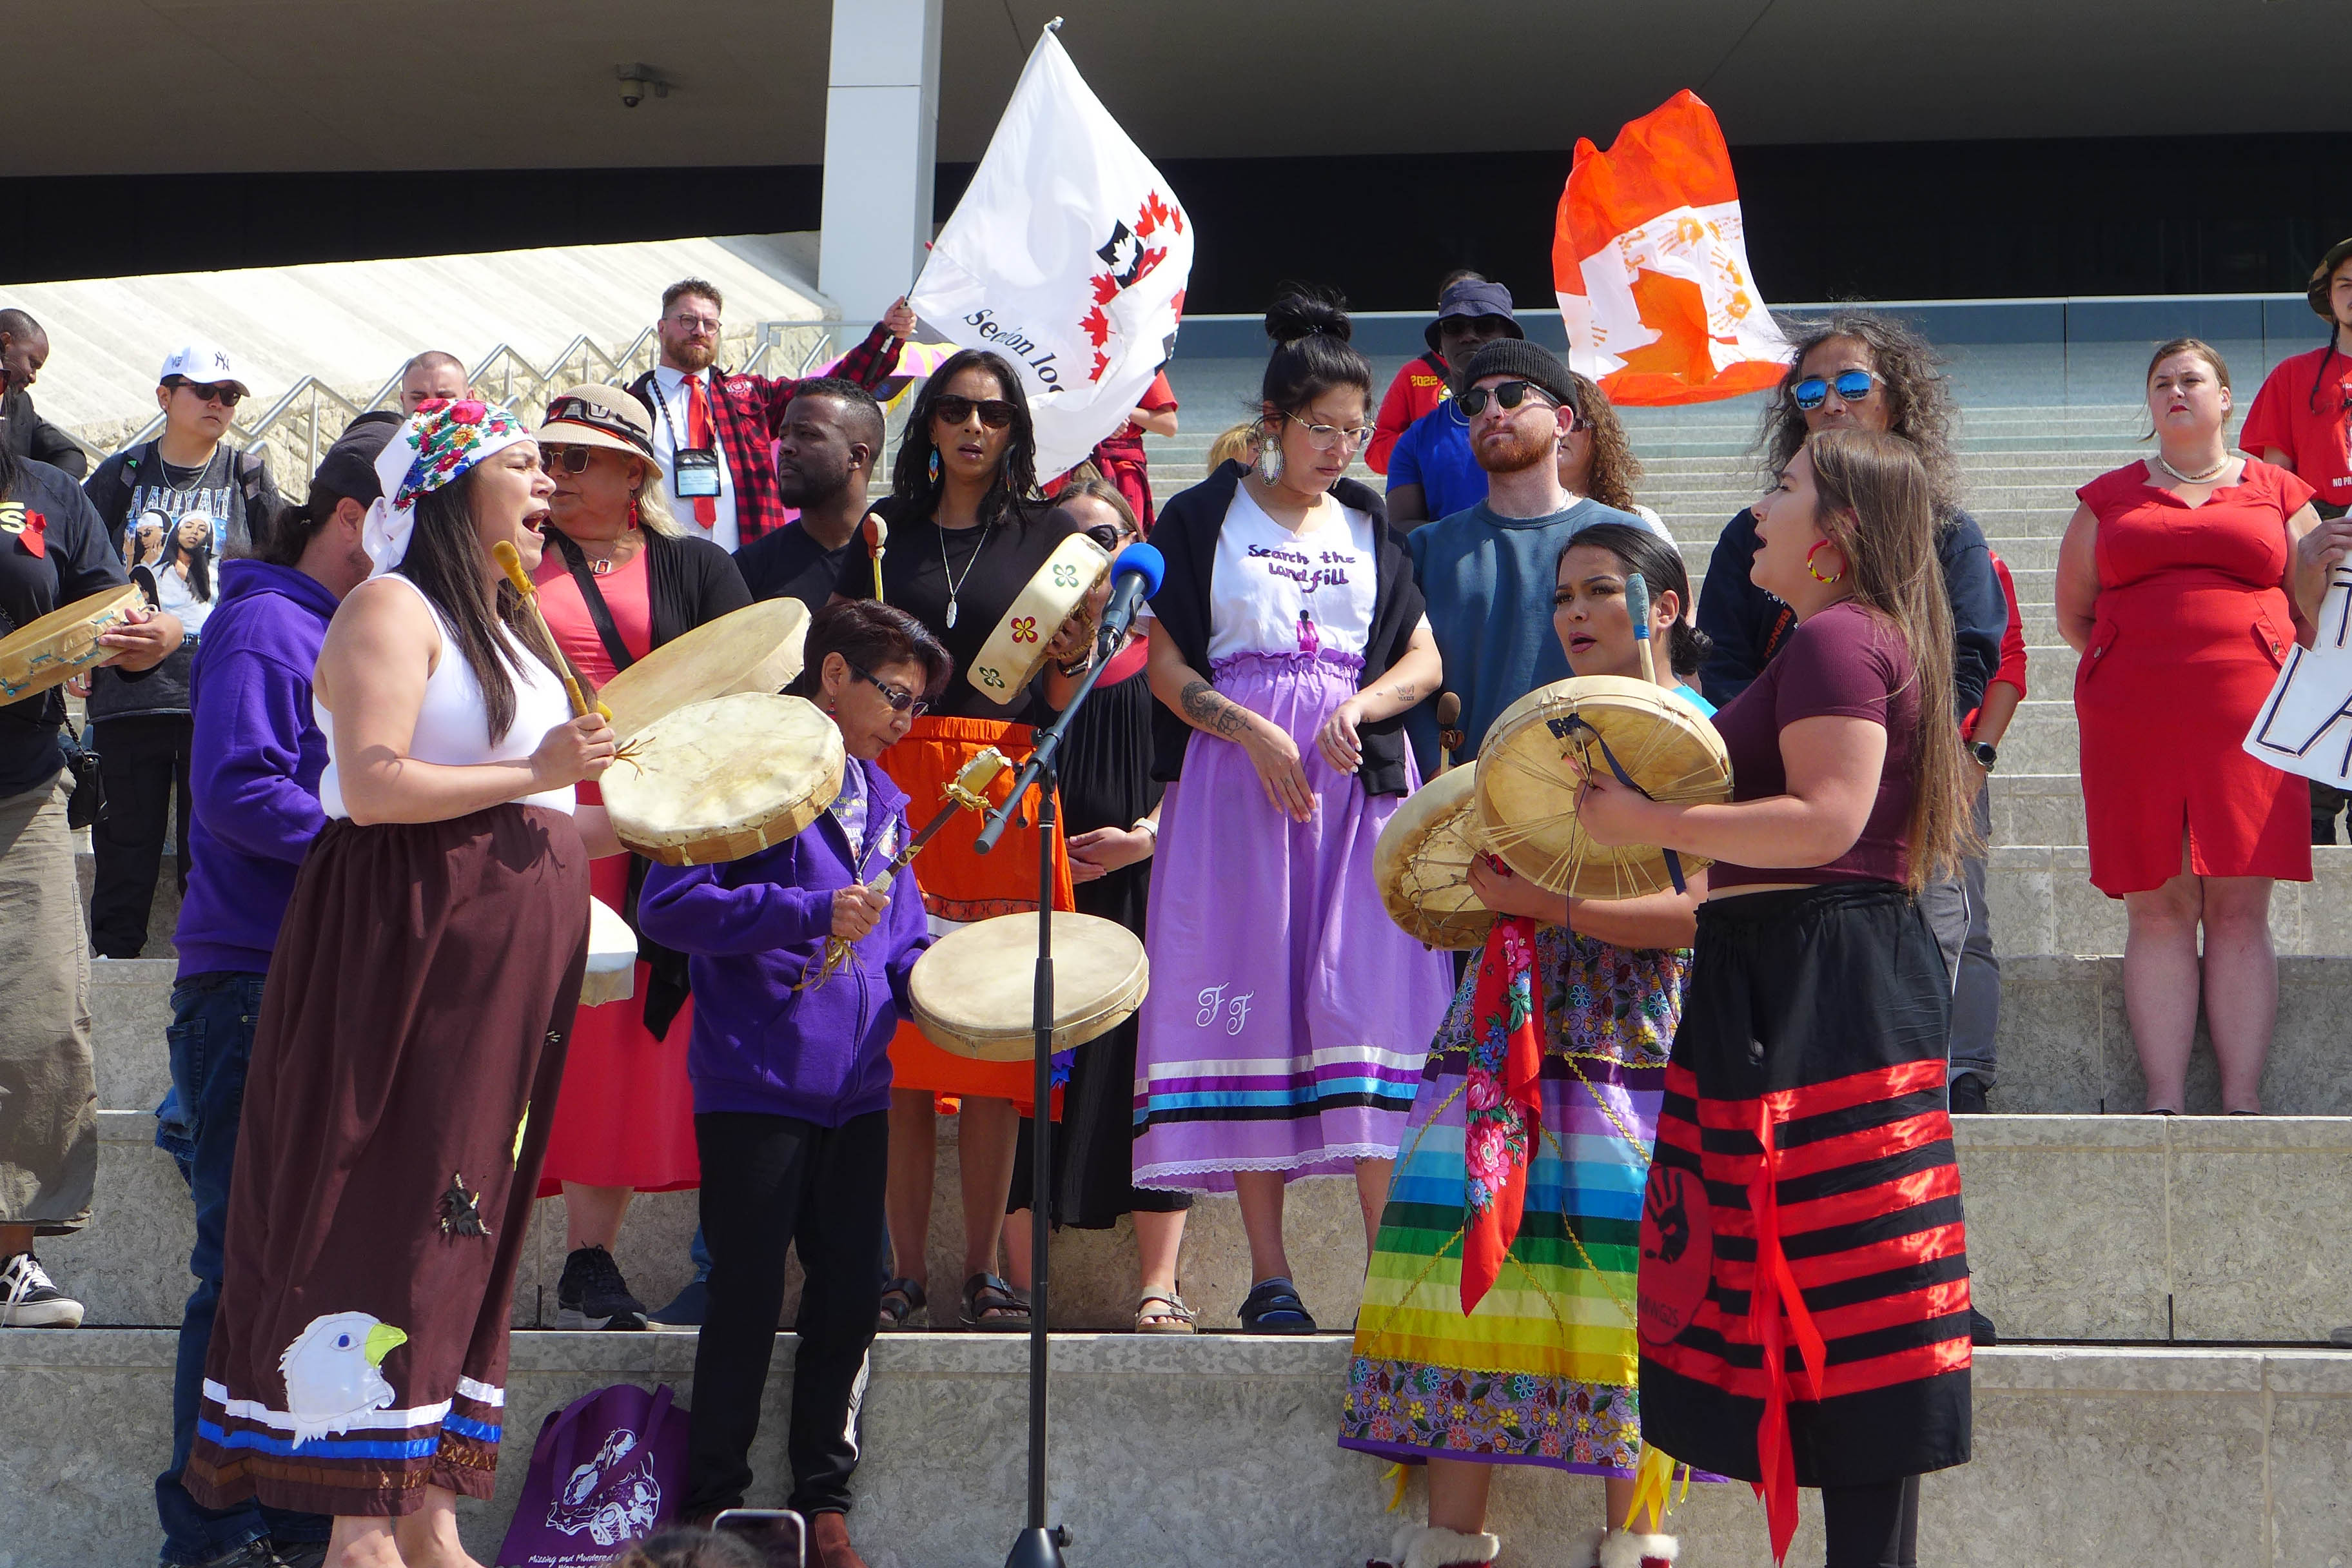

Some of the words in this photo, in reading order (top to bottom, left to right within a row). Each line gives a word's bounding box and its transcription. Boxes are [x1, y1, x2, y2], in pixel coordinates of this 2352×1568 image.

[1410, 375, 1438, 387] 2022
[126, 485, 231, 521] AALIYAH
[1248, 544, 1310, 565] Search
[1319, 551, 1356, 564] the
[558, 1554, 575, 1563] and
[576, 1553, 612, 1562] Murdered
